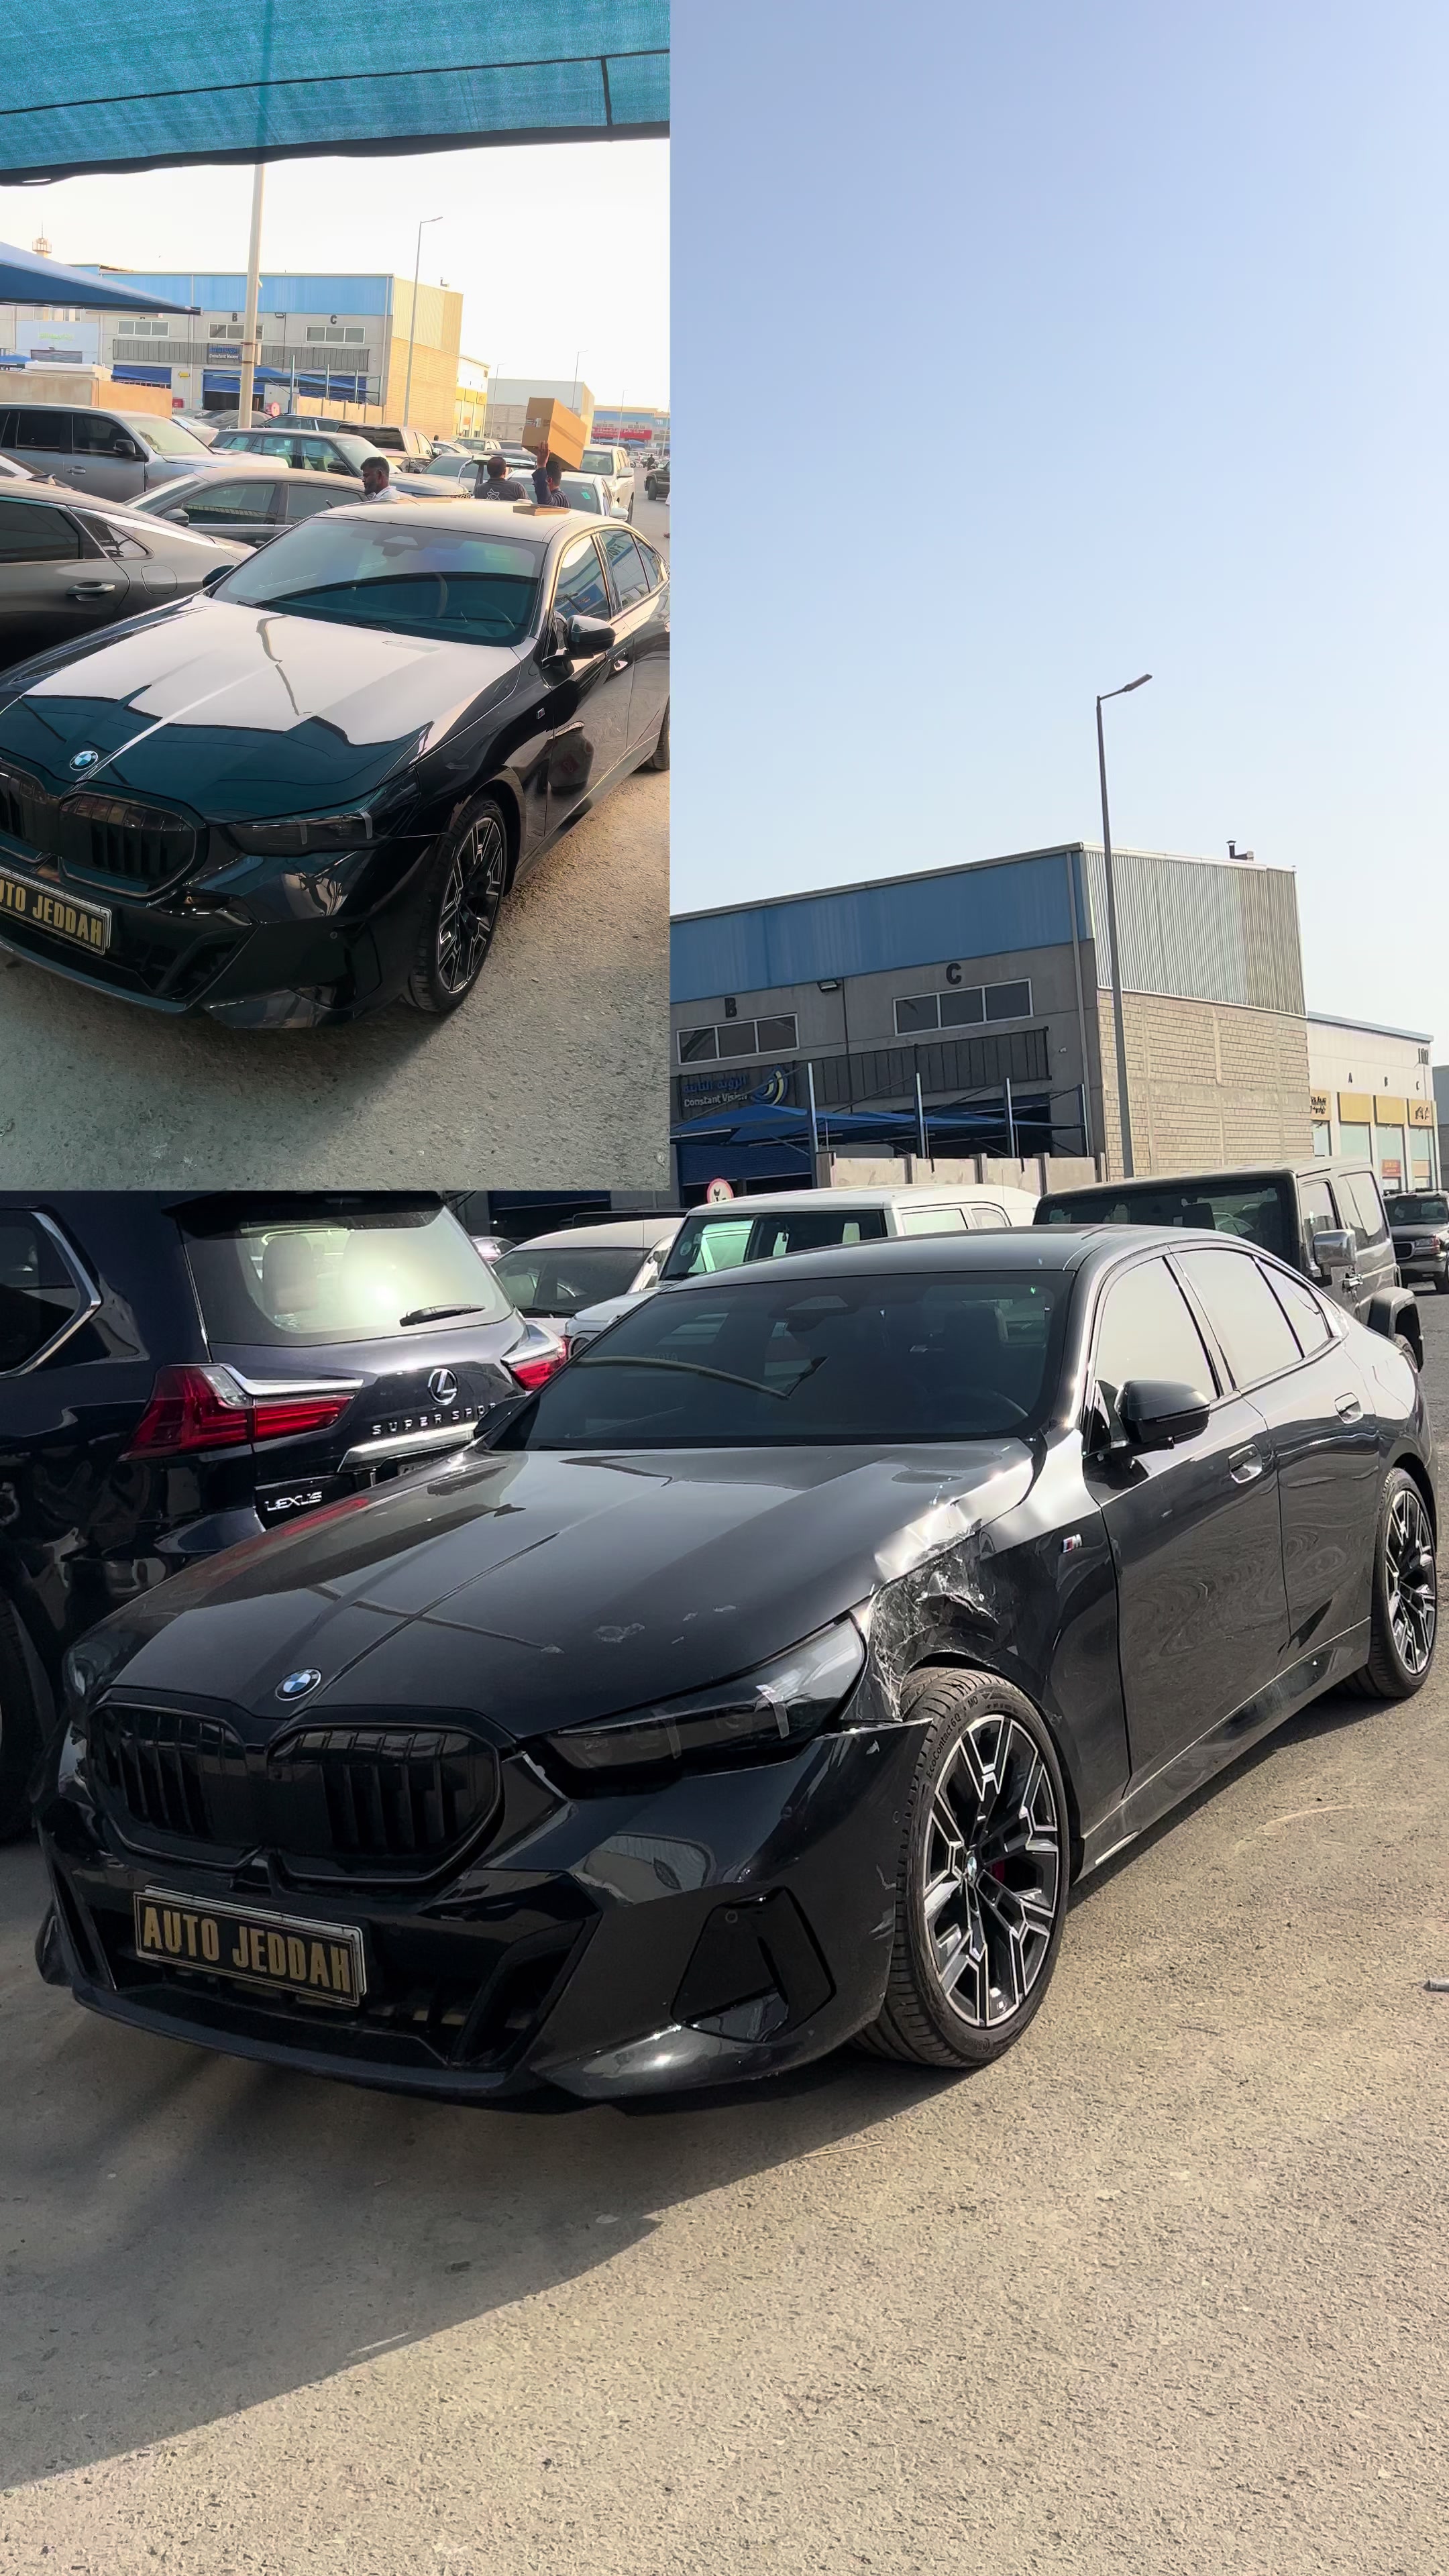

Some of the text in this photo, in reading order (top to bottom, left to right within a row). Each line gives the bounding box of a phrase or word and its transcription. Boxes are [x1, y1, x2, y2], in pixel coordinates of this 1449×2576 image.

[232, 313, 237, 322] B
[330, 315, 337, 325] C
[32, 894, 102, 947] JEDDAH
[946, 962, 961, 985] C
[724, 997, 737, 1018] B
[1348, 1072, 1353, 1083] A
[1384, 1076, 1389, 1087] B
[1415, 1081, 1420, 1091] C
[684, 1091, 747, 1107] Constant Vision
[372, 1413, 443, 1436] SUPER
[264, 1491, 322, 1511] LEXUS
[926, 1724, 953, 1779] EcoContact
[143, 1906, 352, 1992] AUTO JEDDAH
